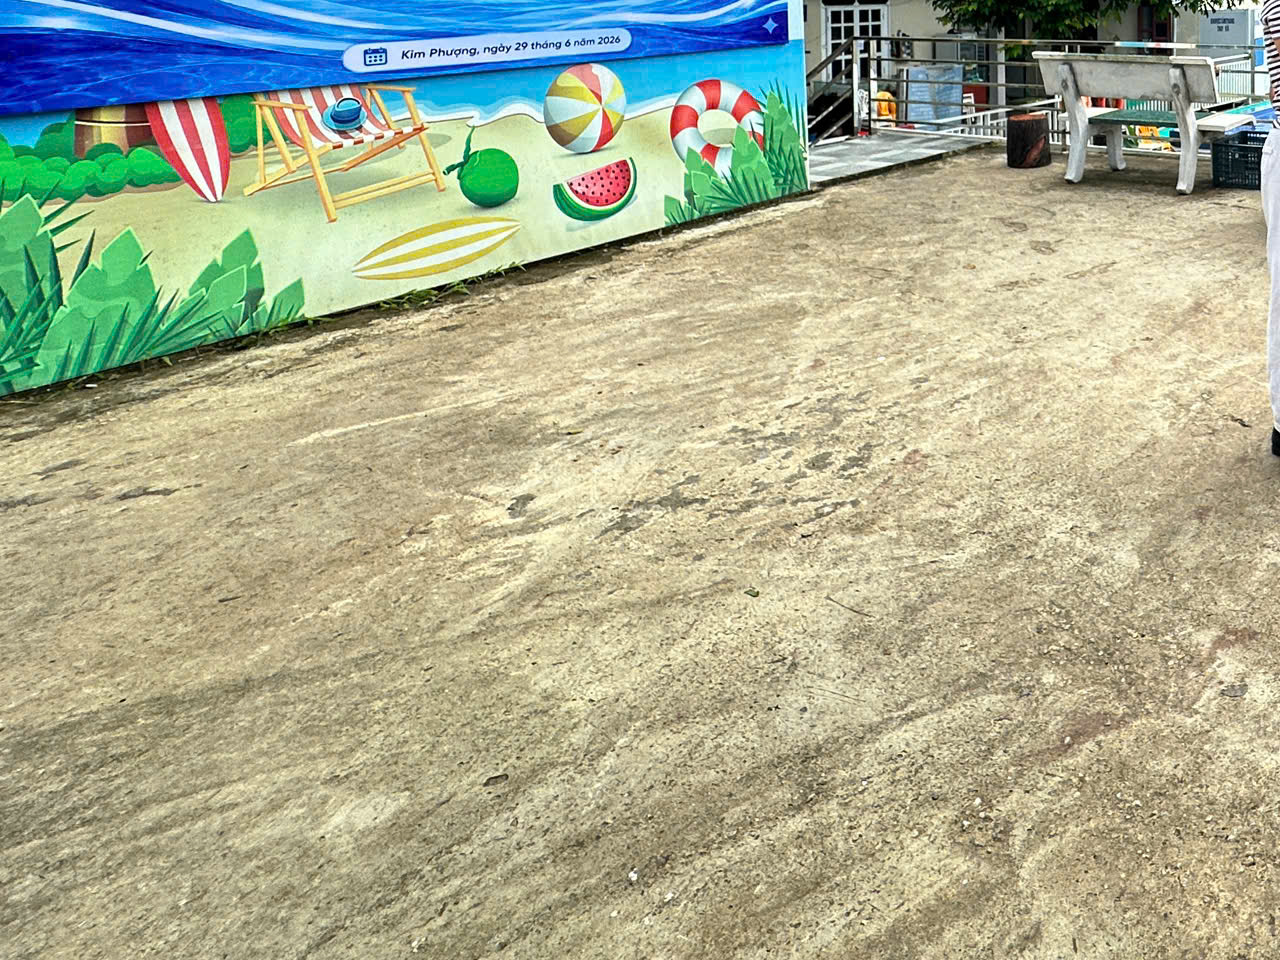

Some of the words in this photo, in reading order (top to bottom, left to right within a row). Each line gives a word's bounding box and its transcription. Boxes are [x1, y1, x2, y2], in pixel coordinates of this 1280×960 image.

[401, 49, 426, 60] Kim
[429, 46, 480, 59] Phượng,
[483, 43, 512, 54] ngày
[514, 41, 528, 51] 29
[530, 39, 562, 50] tháng
[564, 39, 572, 48] 6
[573, 37, 596, 47] năm
[597, 36, 621, 45] 2026
